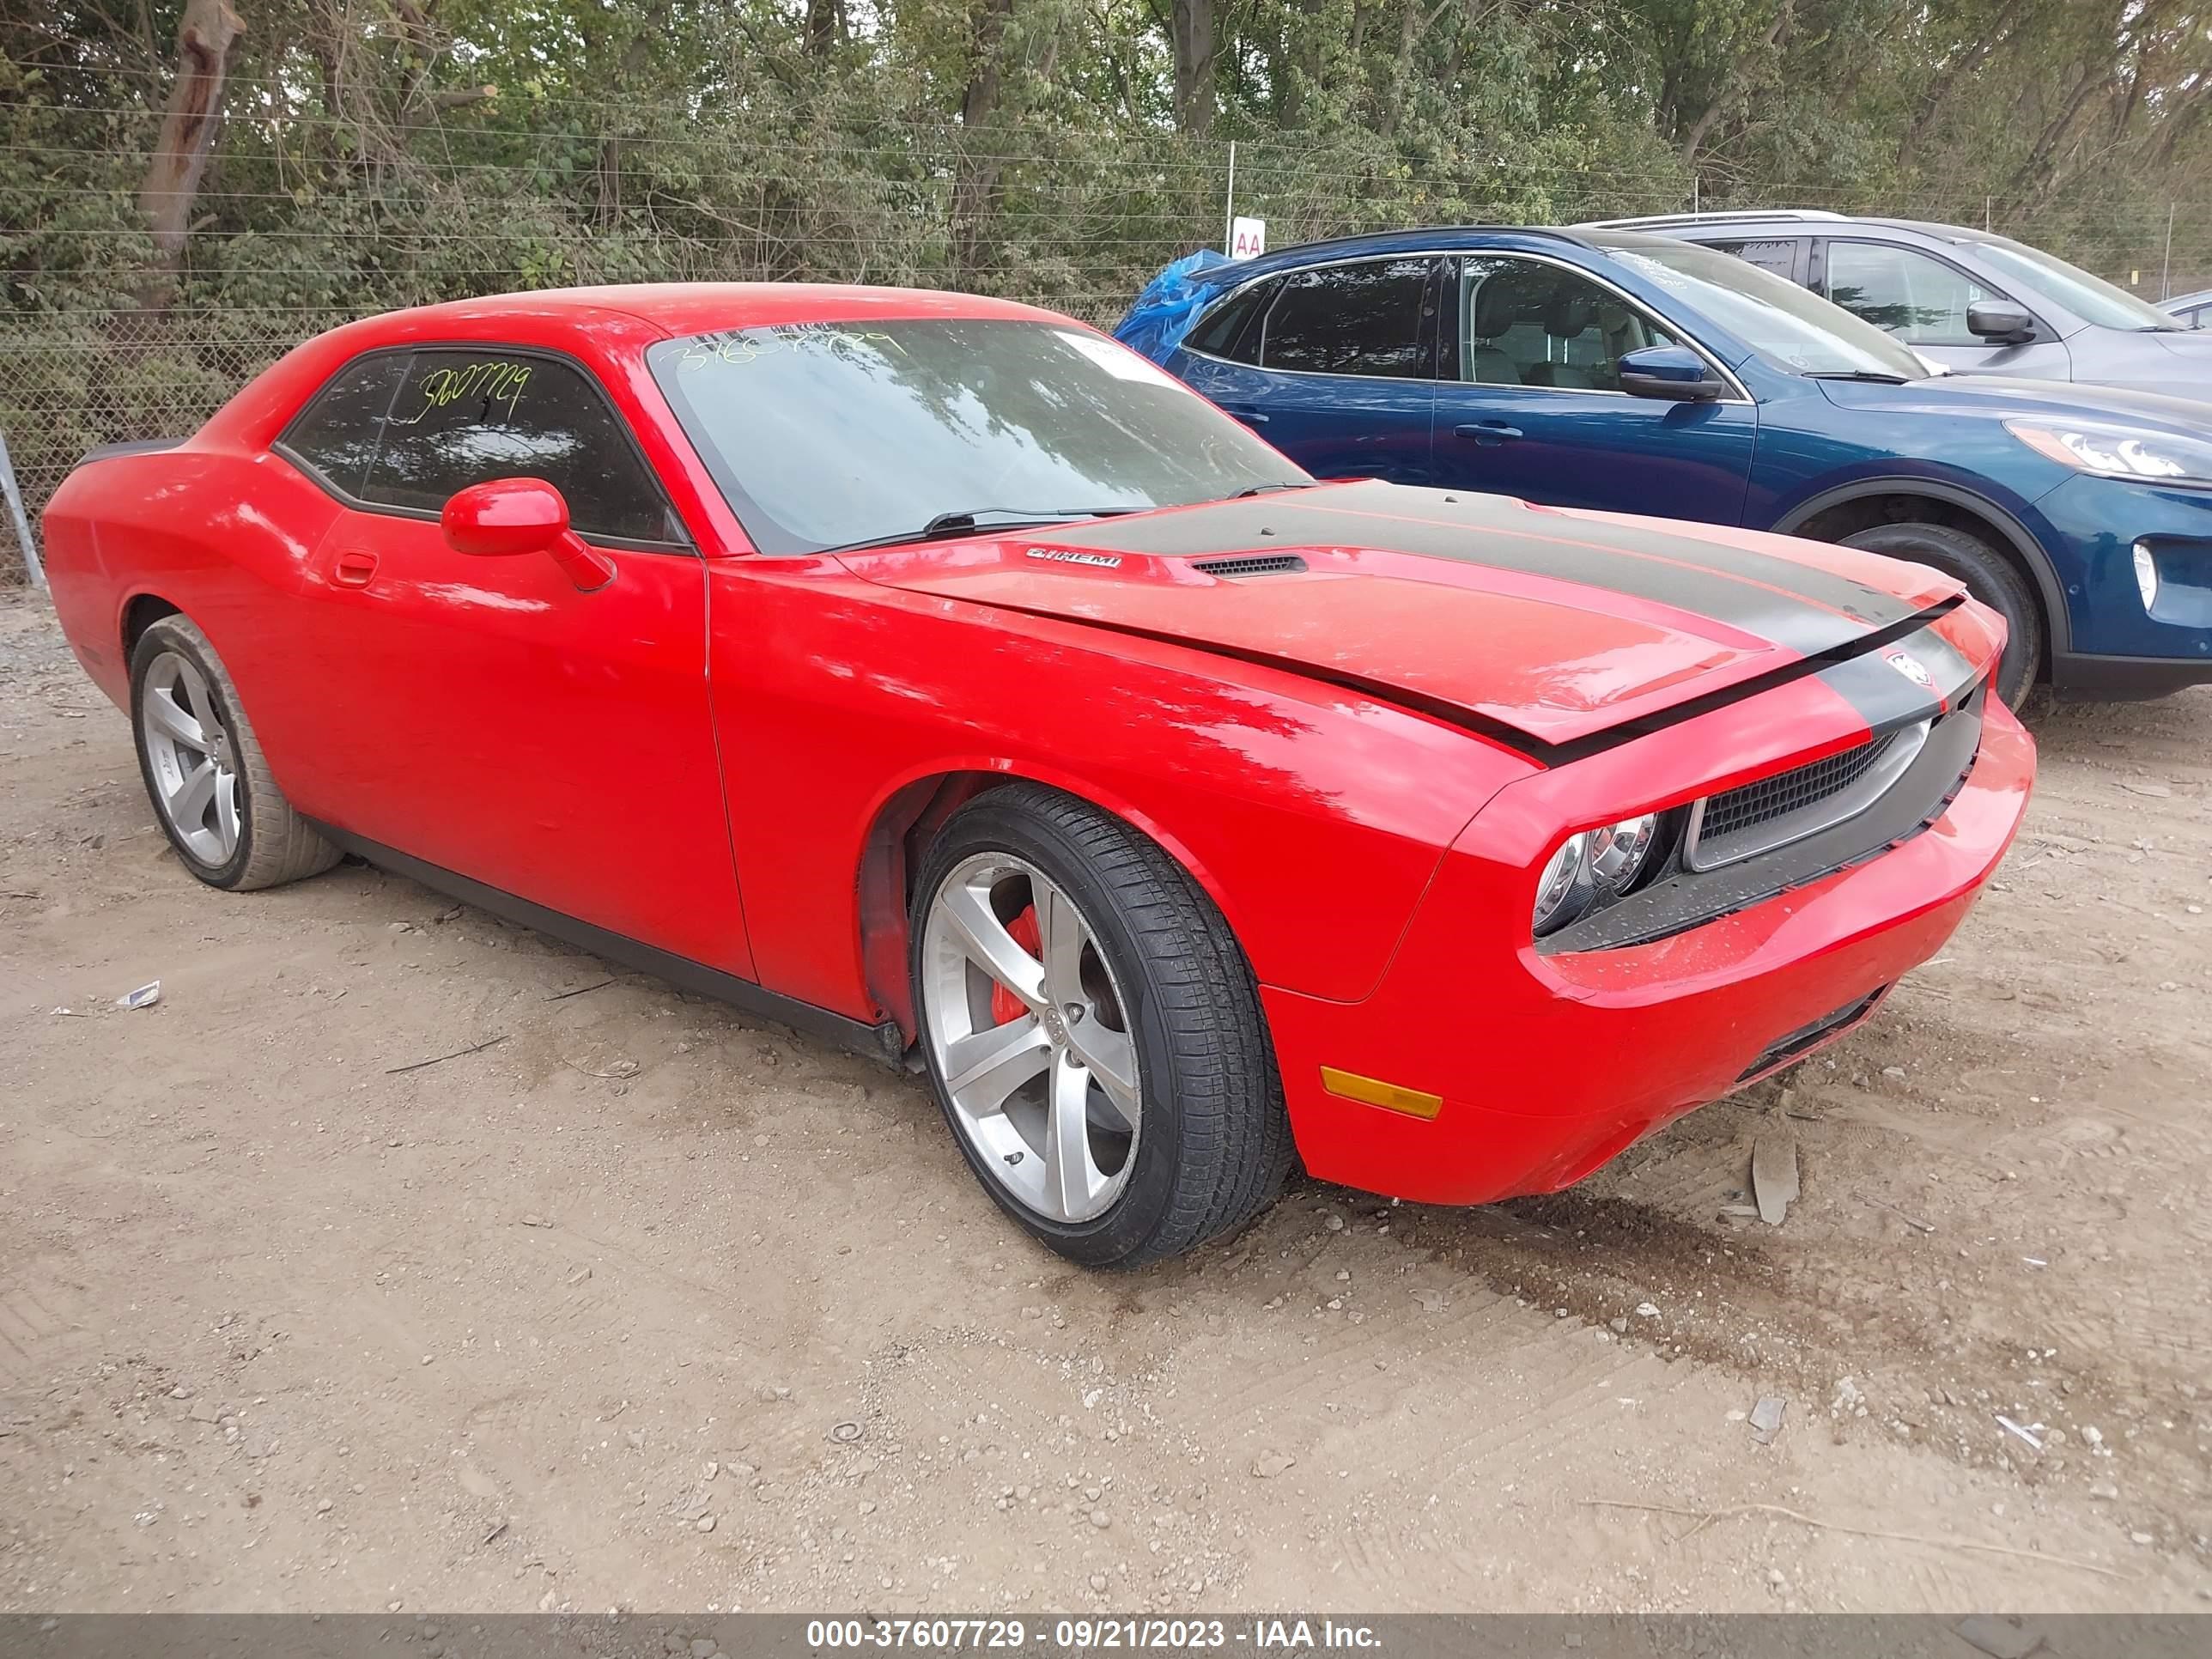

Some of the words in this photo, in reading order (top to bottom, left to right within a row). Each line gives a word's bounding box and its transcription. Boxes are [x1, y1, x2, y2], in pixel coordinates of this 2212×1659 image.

[1236, 233, 1261, 255] AA
[659, 331, 908, 372] 37607729
[407, 362, 532, 424] 37607729
[1055, 551, 1121, 568] HEMI
